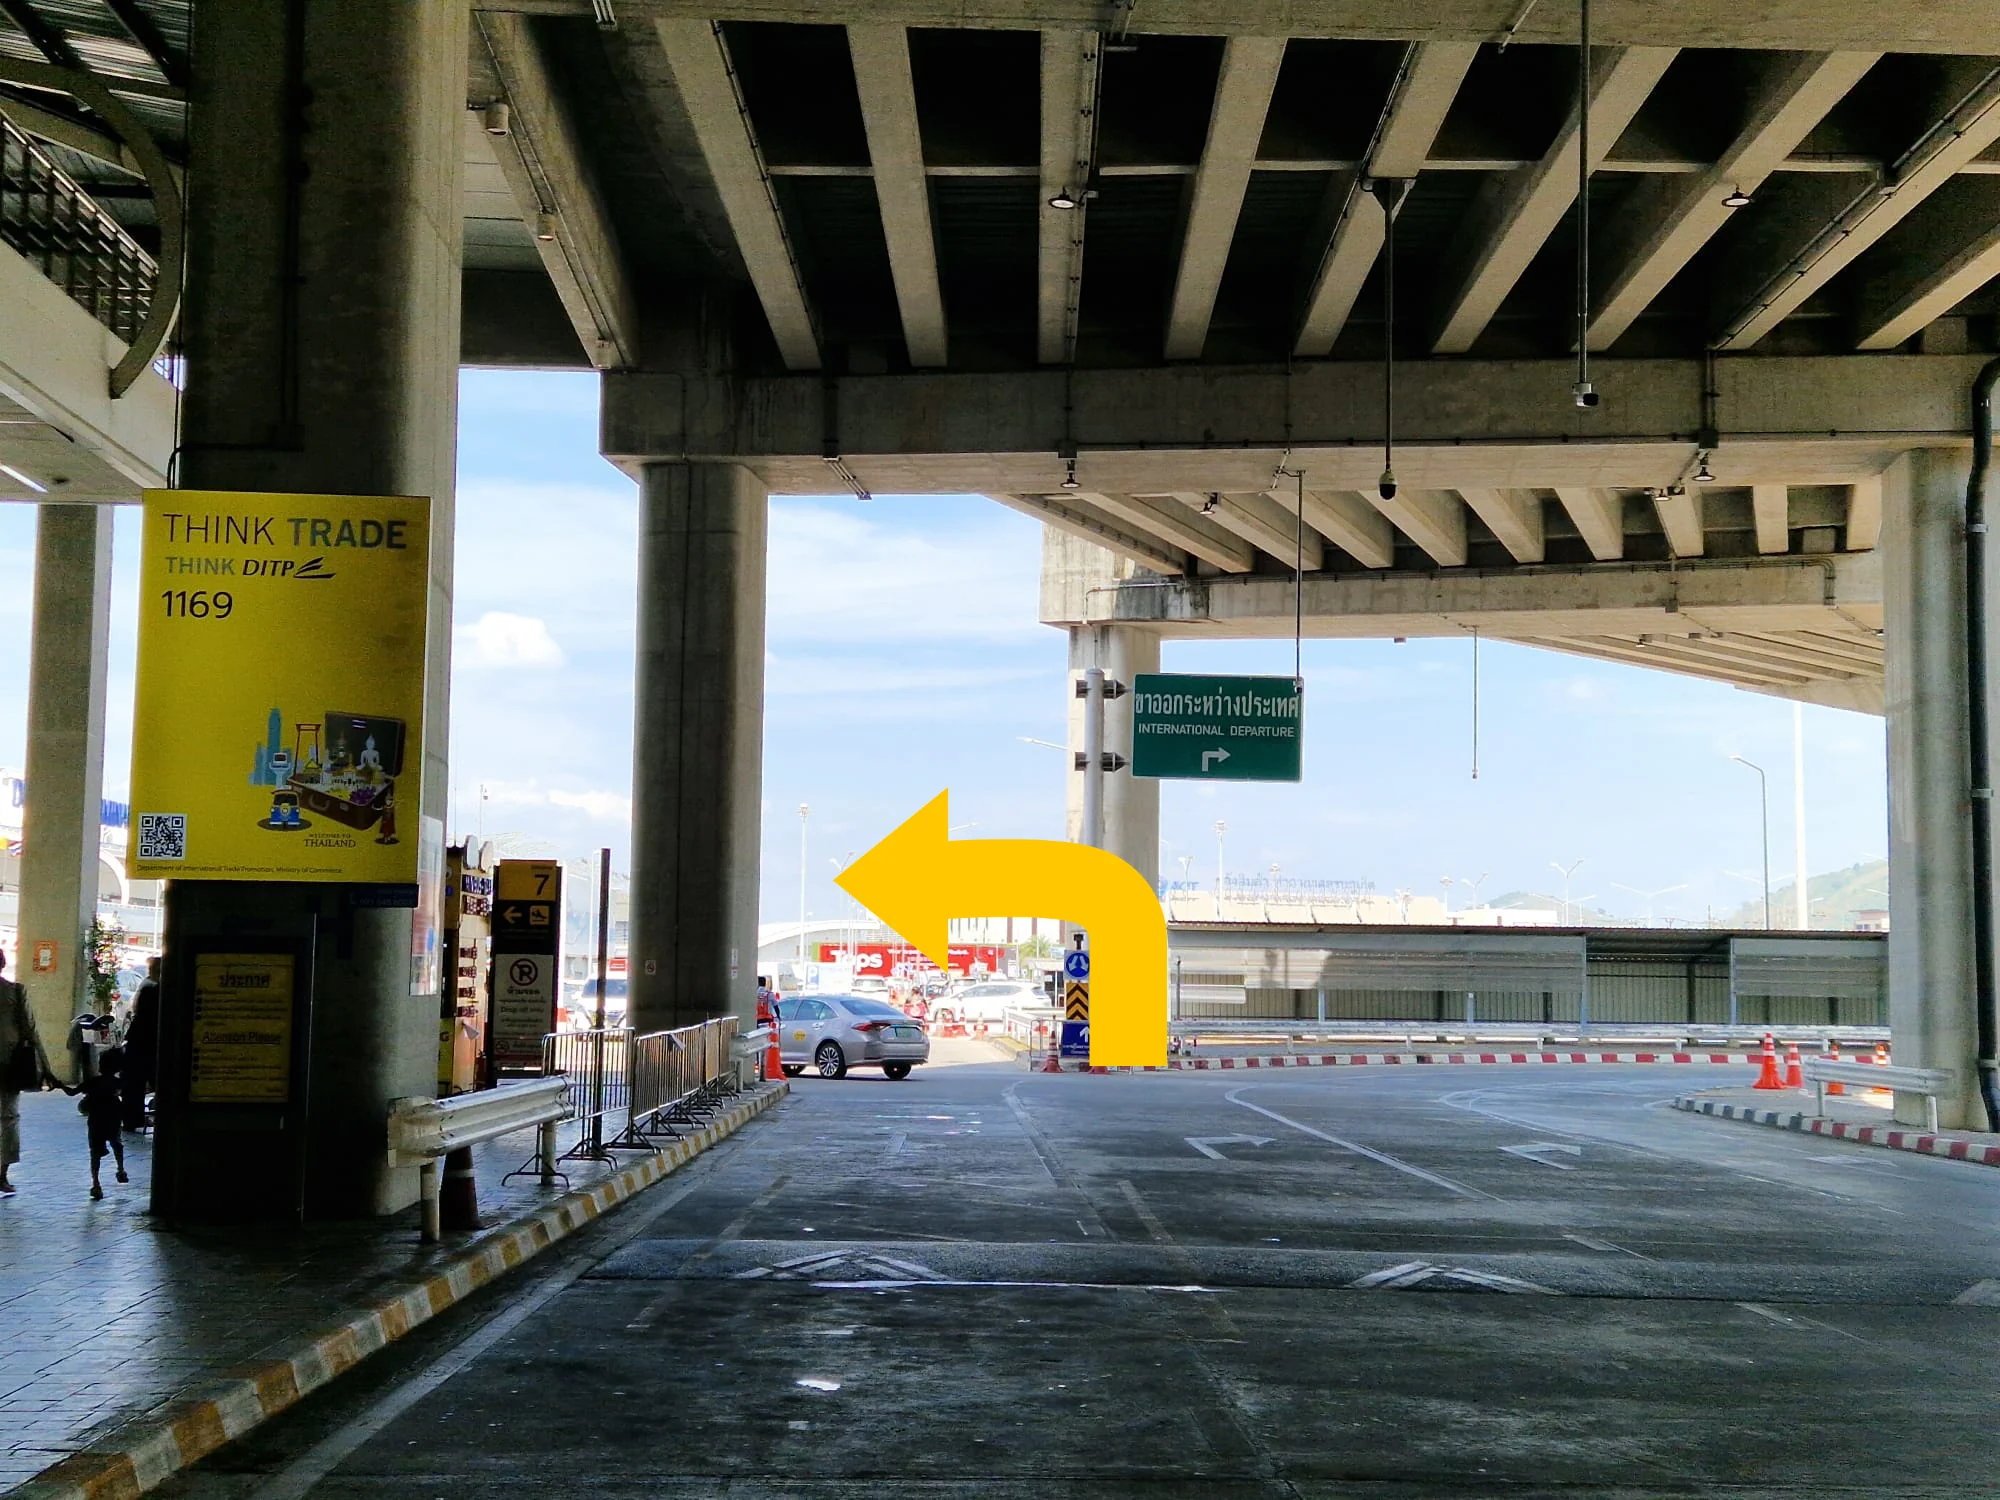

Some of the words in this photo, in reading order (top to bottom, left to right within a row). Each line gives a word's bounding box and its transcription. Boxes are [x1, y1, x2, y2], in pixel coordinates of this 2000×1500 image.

[163, 513, 275, 545] THINK
[287, 518, 407, 549] TRADE
[165, 556, 235, 576] THINK
[242, 559, 295, 577] DITP
[161, 590, 233, 618] 1169
[1136, 687, 1299, 718] ขาออกระหว่างประเทศ
[1138, 723, 1224, 737] INTERNATIONAL
[1230, 725, 1295, 738] DEPARTURE
[303, 838, 357, 848] THAILAND
[534, 874, 550, 896] 7
[831, 949, 883, 970] Tops
